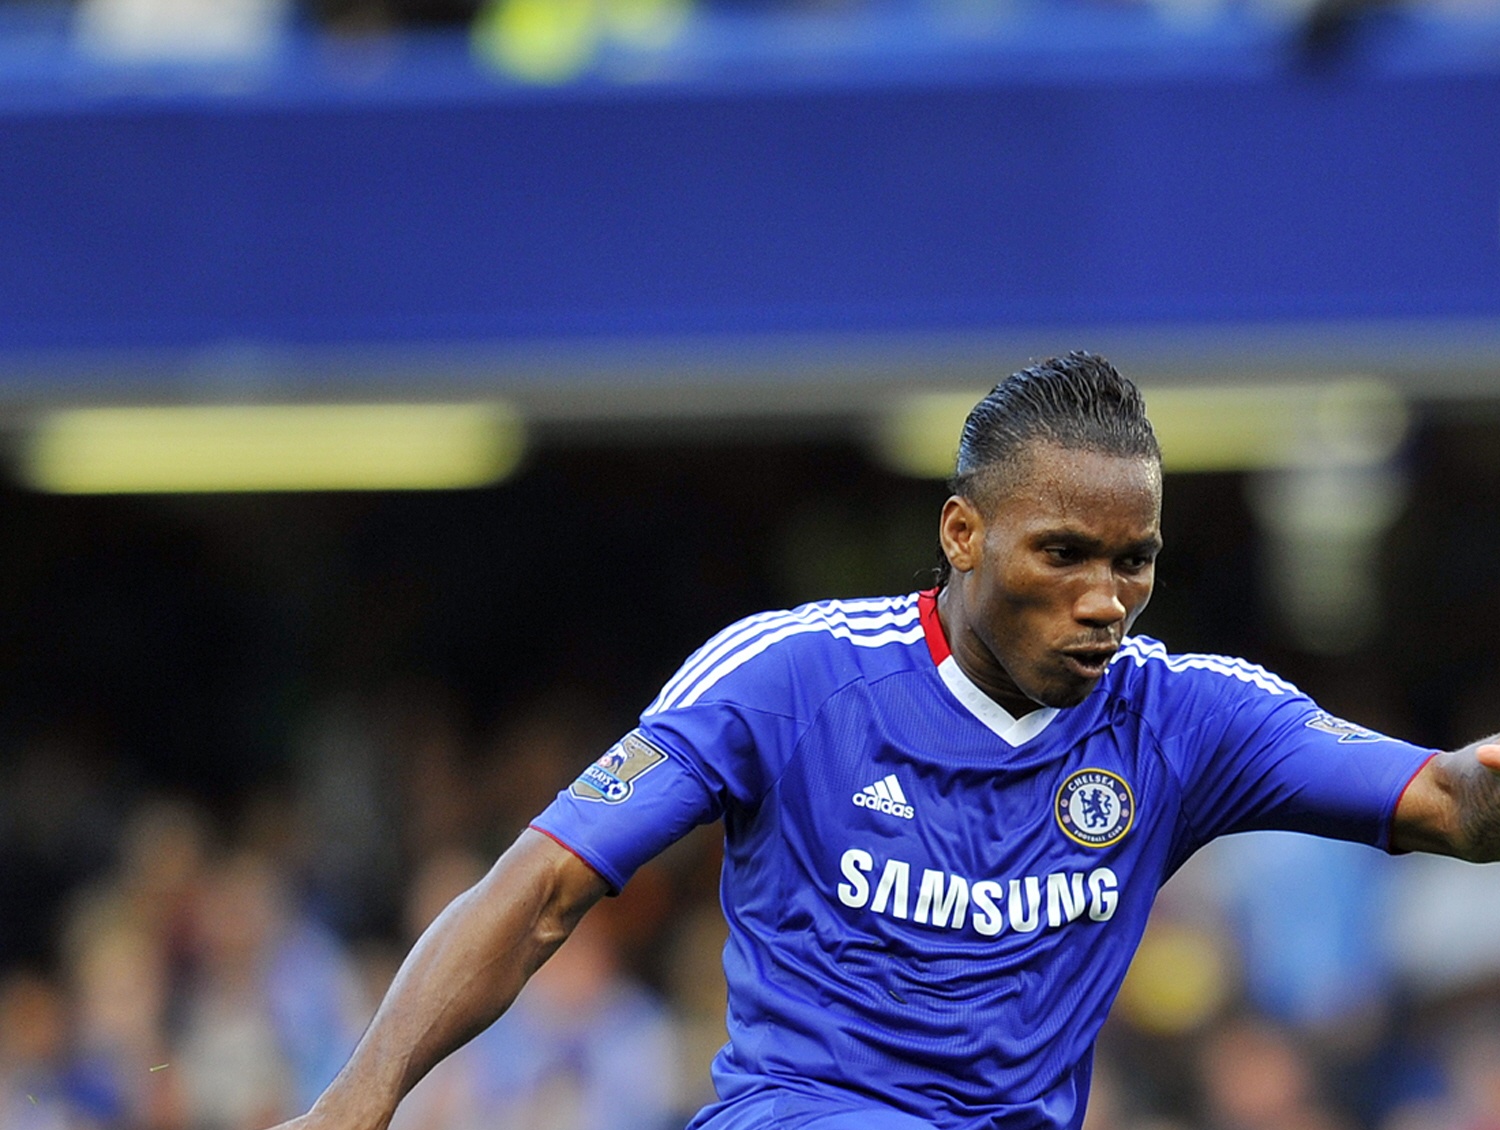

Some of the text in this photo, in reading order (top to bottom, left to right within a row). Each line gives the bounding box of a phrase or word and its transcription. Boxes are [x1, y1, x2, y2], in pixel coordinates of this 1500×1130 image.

[1068, 774, 1115, 792] CHELSEA
[852, 792, 914, 819] adidas
[837, 848, 1119, 936] SAMSUNG
